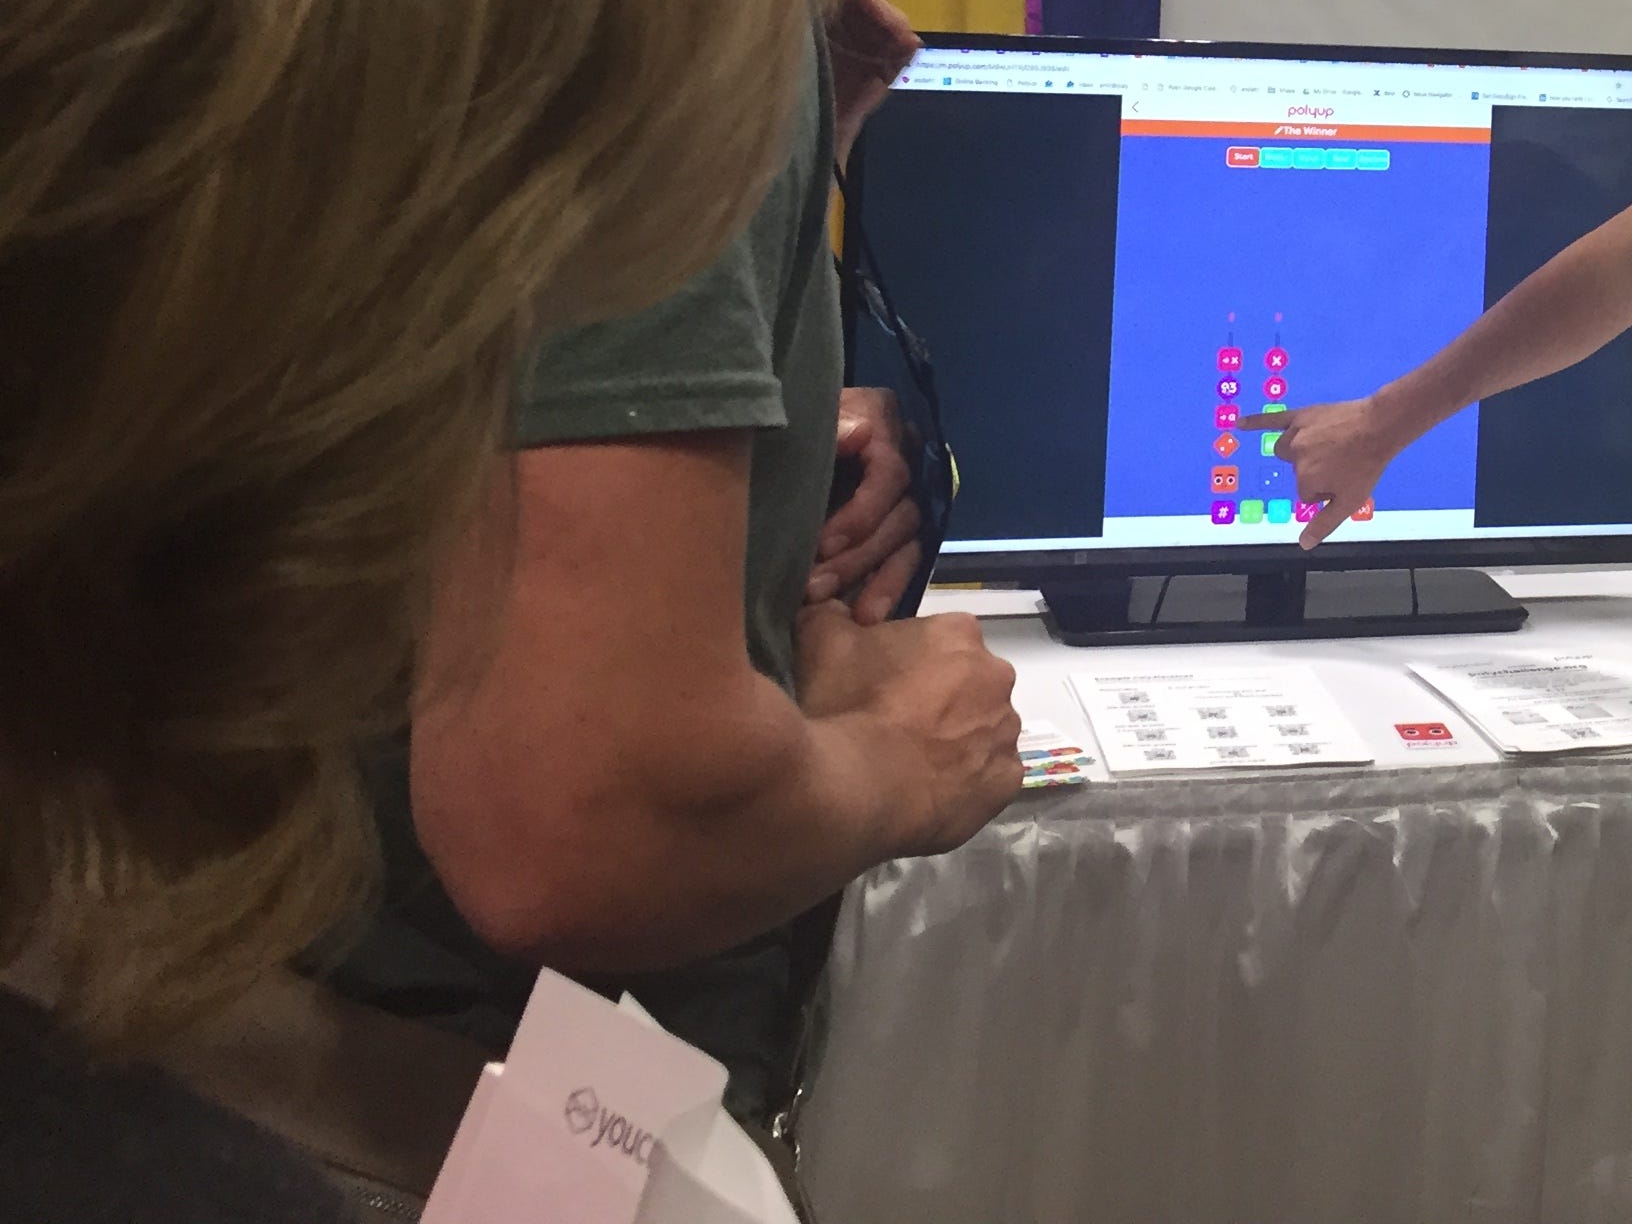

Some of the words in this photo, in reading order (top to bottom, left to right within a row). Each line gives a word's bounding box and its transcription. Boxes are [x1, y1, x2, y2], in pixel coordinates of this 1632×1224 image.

[1287, 104, 1335, 119] polyup
[1281, 126, 1302, 136] The
[1303, 126, 1338, 137] Winner
[1233, 152, 1254, 161] Start
